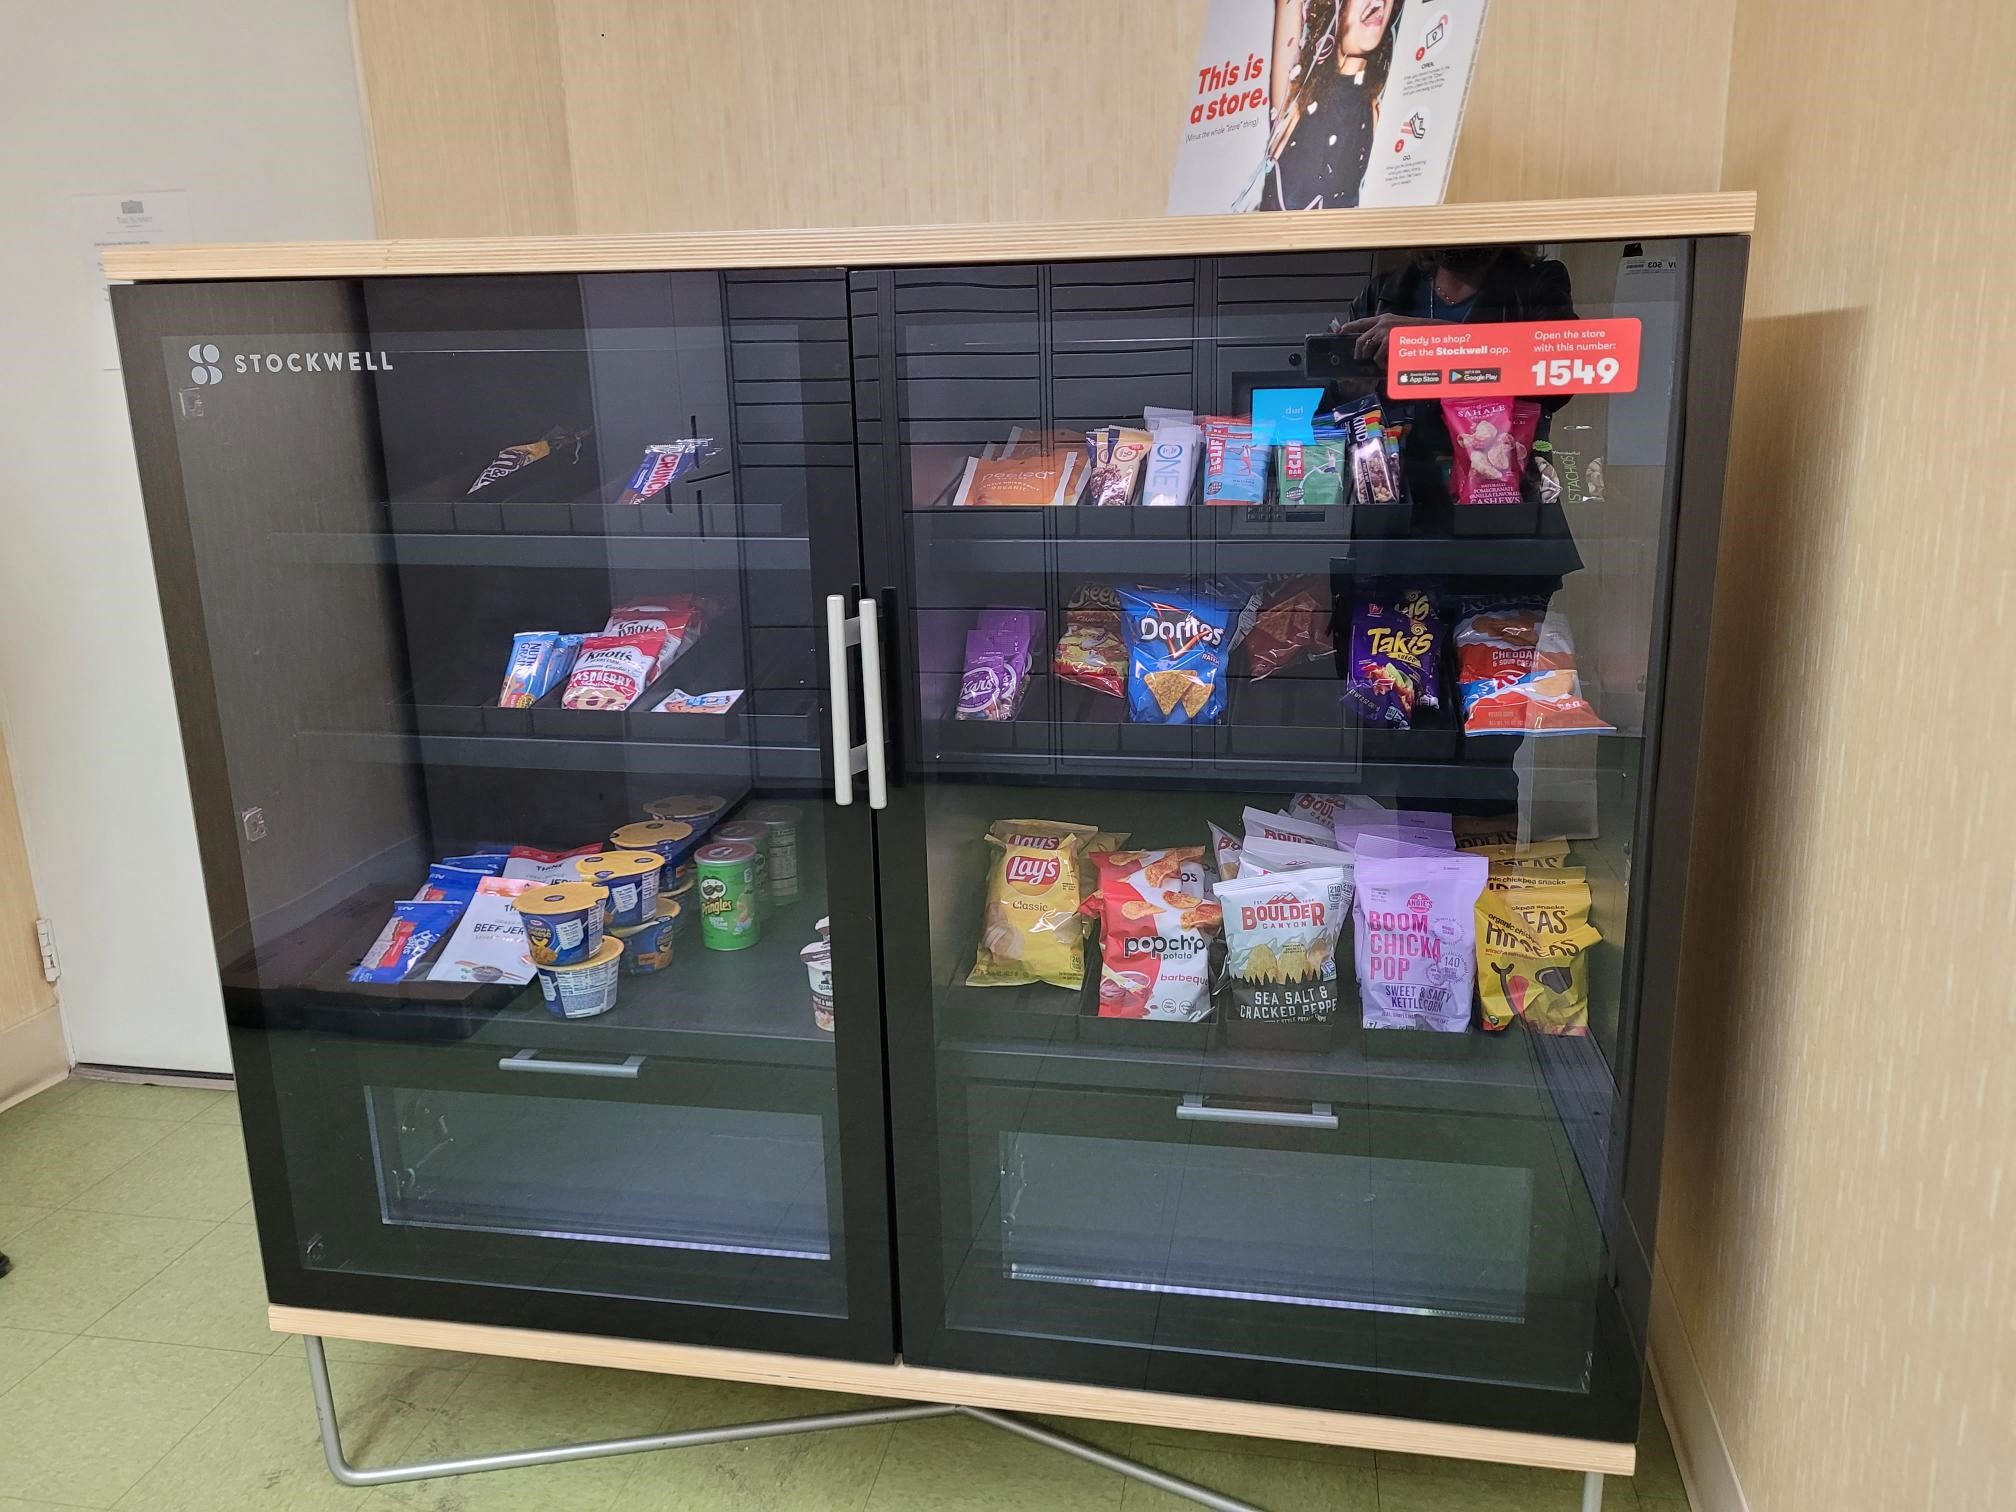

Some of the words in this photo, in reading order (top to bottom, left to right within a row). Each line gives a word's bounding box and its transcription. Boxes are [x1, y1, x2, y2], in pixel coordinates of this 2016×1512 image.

[1199, 60, 1240, 94] This
[1244, 53, 1264, 81] is
[1190, 104, 1204, 124] a
[1206, 88, 1268, 120] store.
[1399, 335, 1429, 346] Ready
[1431, 335, 1441, 344] to
[1443, 333, 1472, 344] shop?
[1534, 330, 1561, 341] Open
[1563, 330, 1579, 338] the
[1581, 330, 1606, 338] store
[1399, 348, 1417, 357] Get
[1419, 348, 1434, 356] the
[1435, 345, 1488, 356] Stockwell
[1489, 346, 1512, 355] app.
[1533, 343, 1554, 352] with
[1556, 343, 1574, 351] this
[1576, 342, 1617, 351] number:
[234, 351, 394, 374] STOCKWELL
[1463, 374, 1485, 382] Google
[1485, 373, 1498, 381] Play
[1531, 357, 1620, 386] 1549
[1409, 376, 1422, 384] App
[1457, 404, 1506, 417] SAHALE
[1352, 415, 1368, 442] KIND
[1210, 440, 1223, 468] CLIF
[1288, 440, 1302, 468] CLIF
[1153, 444, 1183, 488] ONE
[1141, 613, 1224, 646] Doritos
[1367, 622, 1434, 656] Takis
[584, 651, 633, 662] Knott's
[1397, 653, 1417, 663] FUEGO
[1492, 650, 1540, 661] CHEDDAR
[1516, 659, 1540, 668] CREAM
[536, 862, 564, 872] THINK
[1008, 856, 1059, 885] Lay's
[1329, 885, 1341, 893] 210
[702, 899, 732, 915] Pringles
[1012, 900, 1049, 912] Classic
[1407, 899, 1433, 909] ANGIE'S
[1241, 903, 1326, 931] BOULDER
[1369, 910, 1428, 934] BOOM
[1488, 913, 1515, 930] organic
[474, 923, 501, 933] BEEF
[1262, 922, 1307, 930] CANYON
[1124, 935, 1206, 959] popchip
[1370, 933, 1442, 964] CHICKA
[1163, 953, 1193, 961] potato
[1445, 957, 1460, 968] 140
[1370, 956, 1410, 981] POP
[1255, 991, 1280, 1005] SEA
[1285, 988, 1316, 1005] SALT
[1319, 985, 1328, 998] &
[1385, 985, 1417, 997] SWEET
[1419, 986, 1426, 997] &
[1426, 988, 1453, 1003] SALTY
[1240, 1004, 1297, 1019] CRACKED
[1302, 998, 1338, 1016] PEPPE
